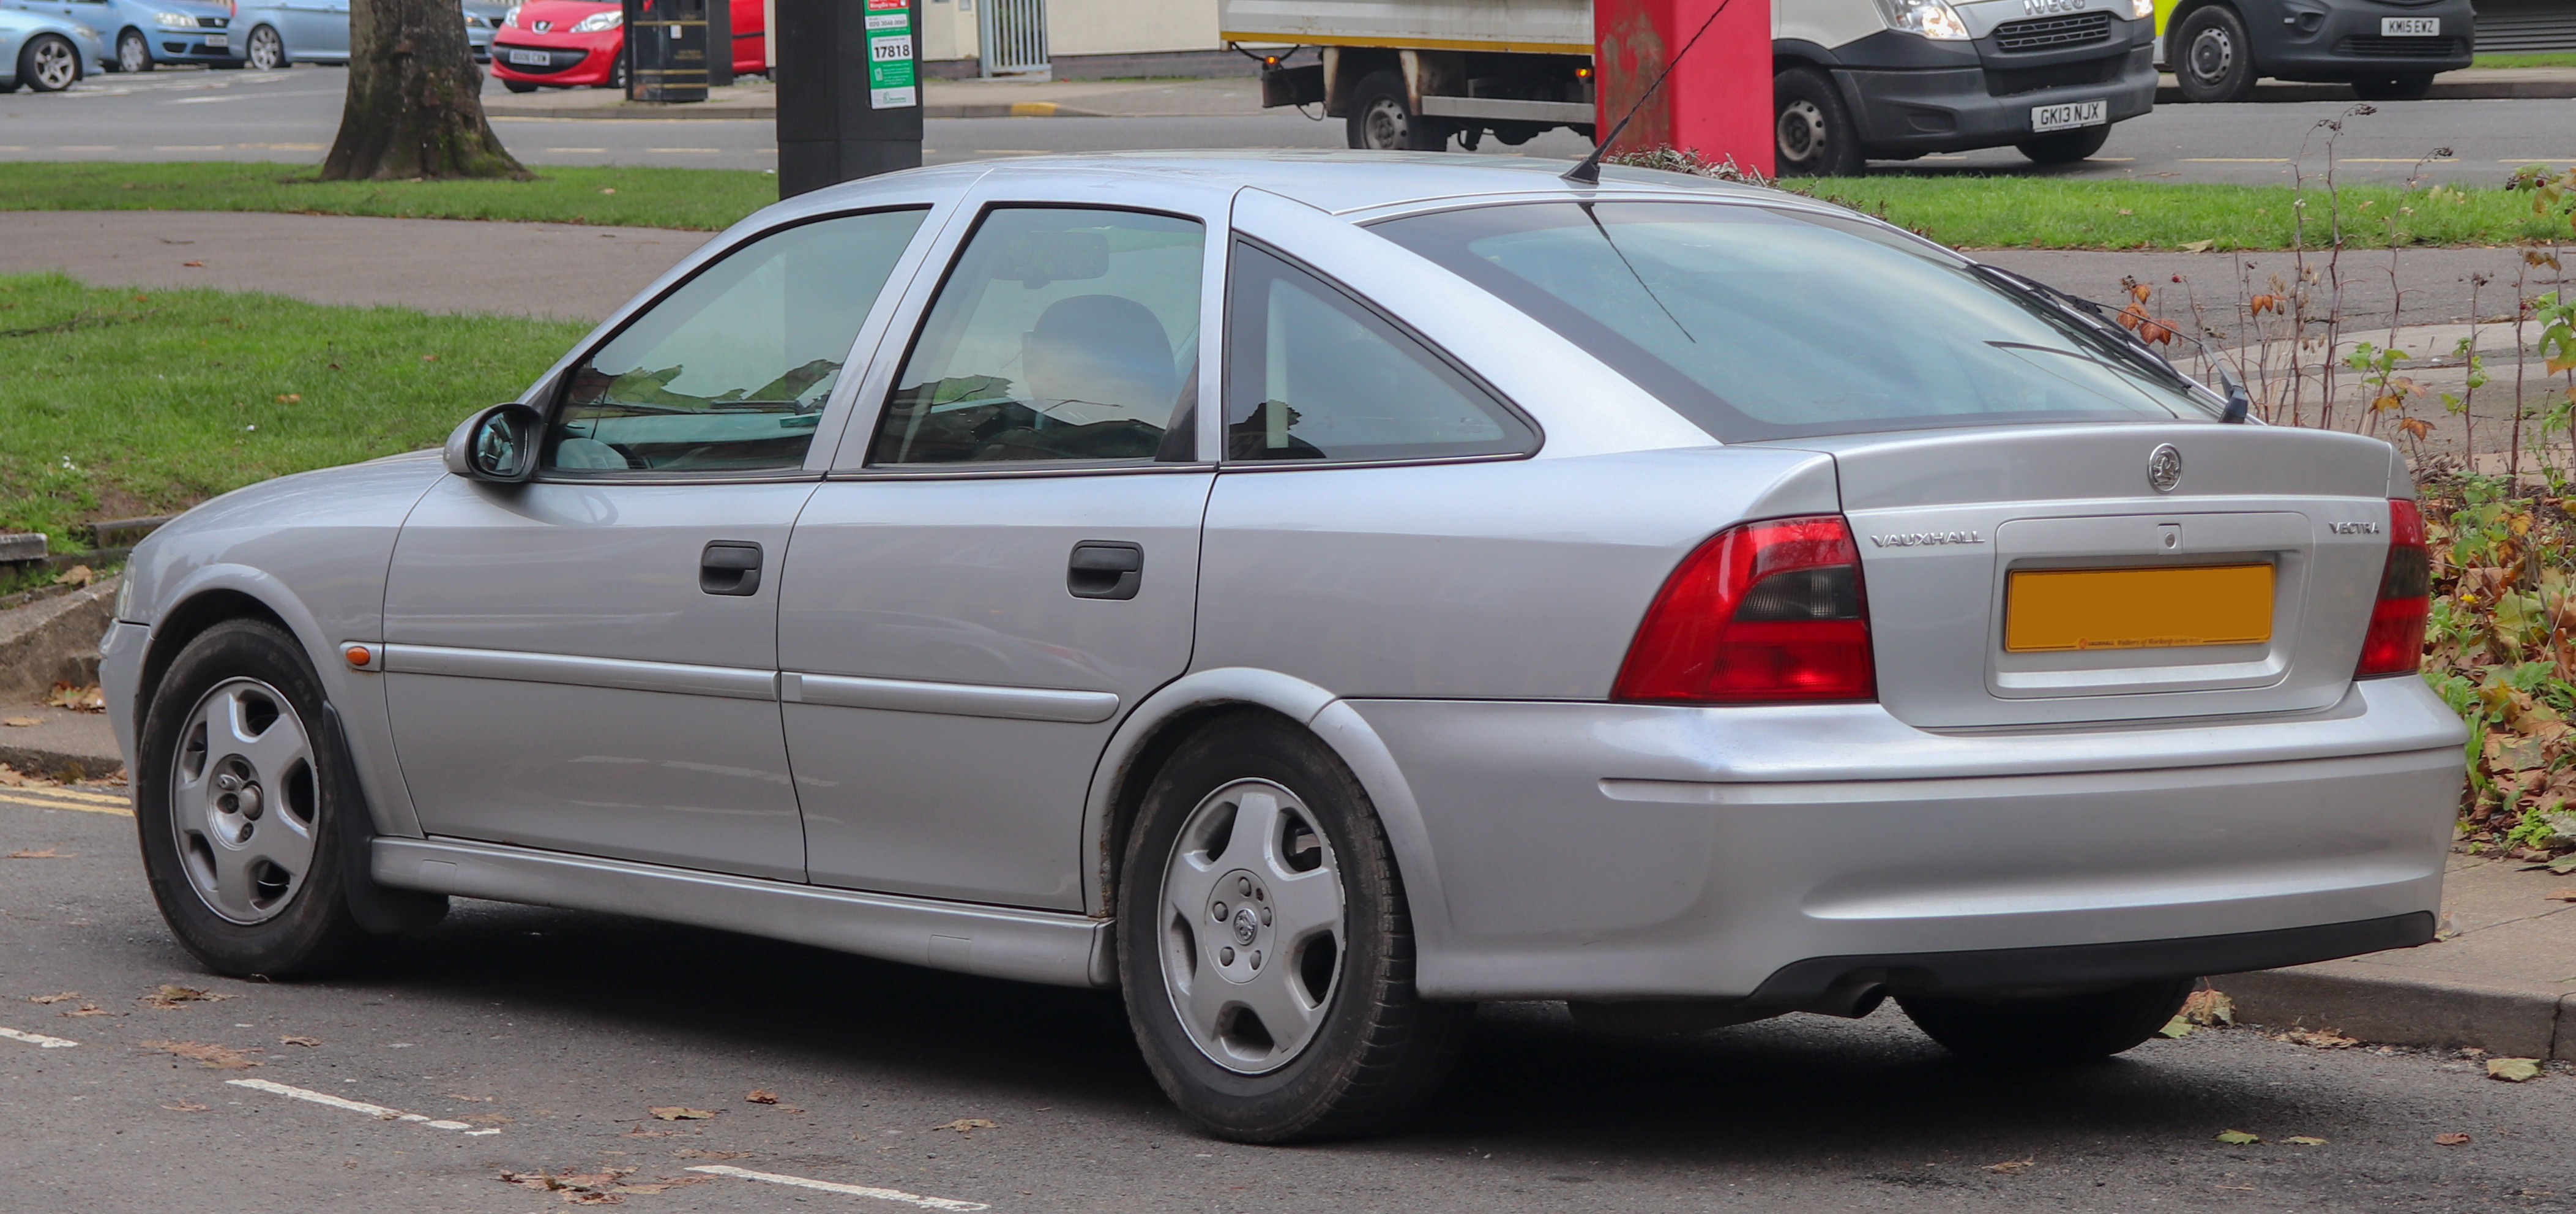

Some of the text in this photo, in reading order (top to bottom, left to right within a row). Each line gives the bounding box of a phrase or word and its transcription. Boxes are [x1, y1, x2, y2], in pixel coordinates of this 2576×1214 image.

[2022, 0, 2085, 15] IVECO
[2389, 20, 2433, 33] KM15 EWZ
[874, 44, 910, 58] 17818
[2041, 103, 2099, 125] GK13 NJX
[2328, 521, 2380, 534] VECTRA
[1870, 531, 1985, 548] VAUXHALL
